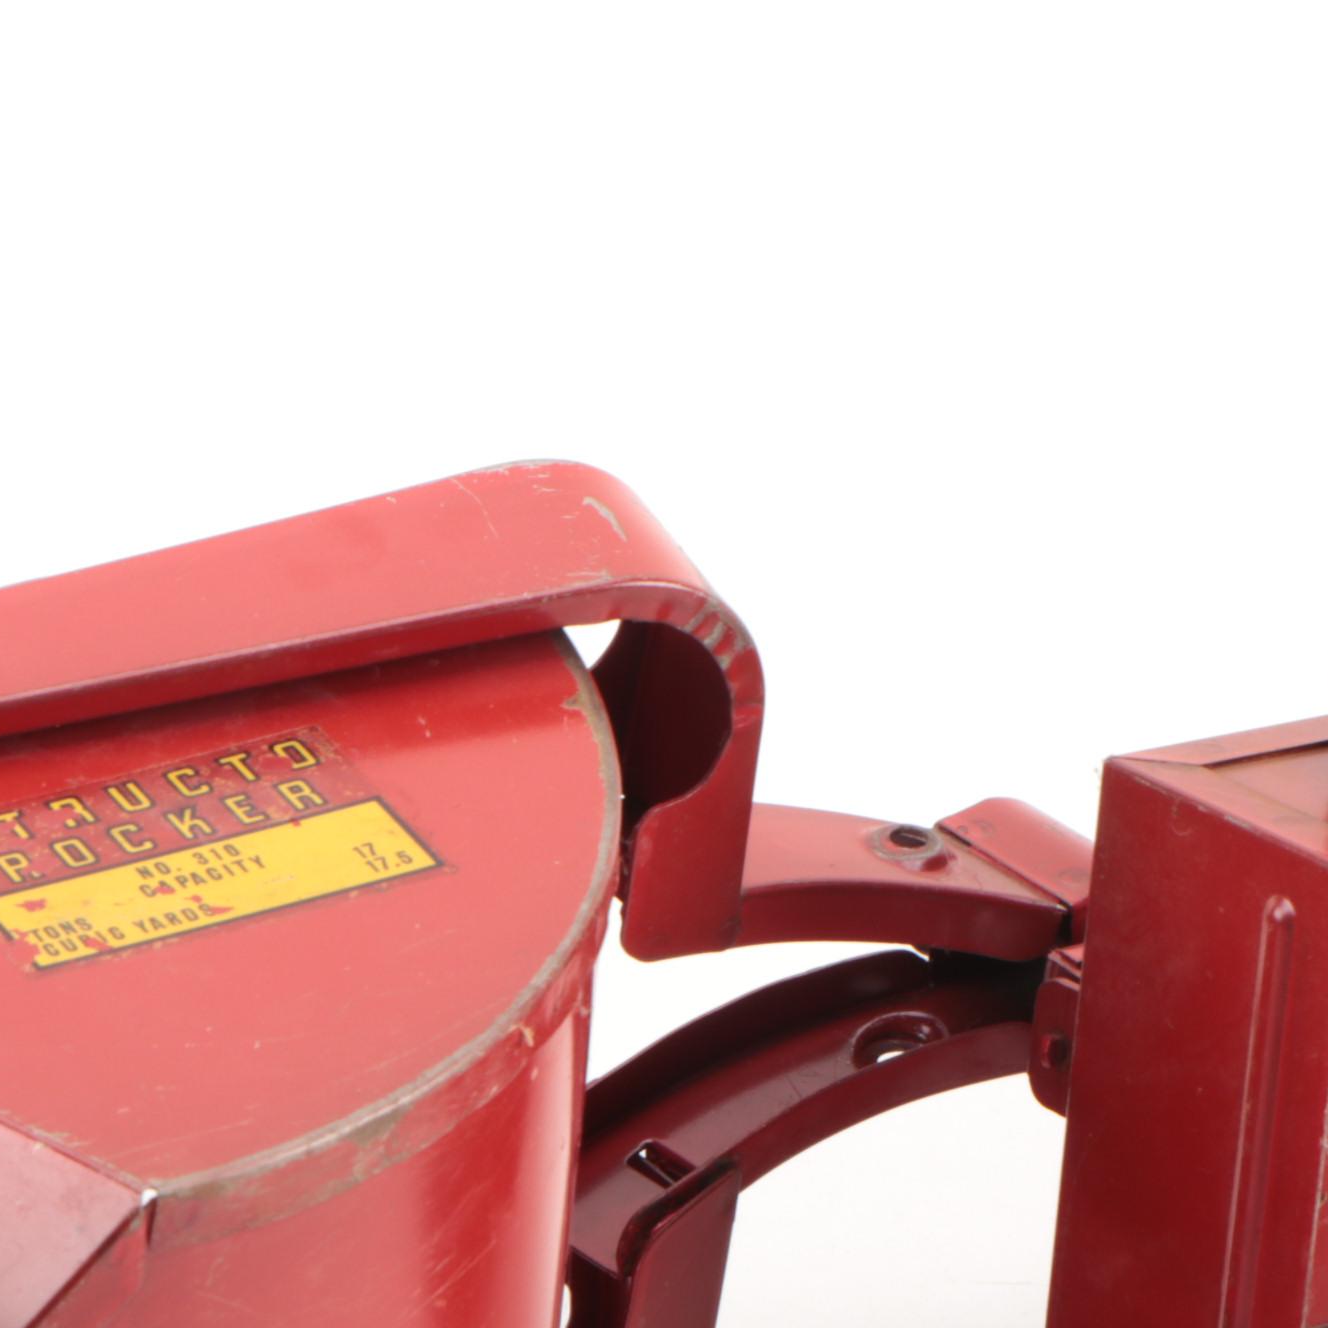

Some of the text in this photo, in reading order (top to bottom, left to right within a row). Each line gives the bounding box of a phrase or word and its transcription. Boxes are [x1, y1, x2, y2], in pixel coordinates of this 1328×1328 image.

[135, 843, 241, 880] NO. 310
[138, 854, 266, 898] CAPACITY
[31, 842, 377, 942] TONS 17
[42, 925, 127, 957] CUBIC
[132, 903, 217, 934] YARDS
